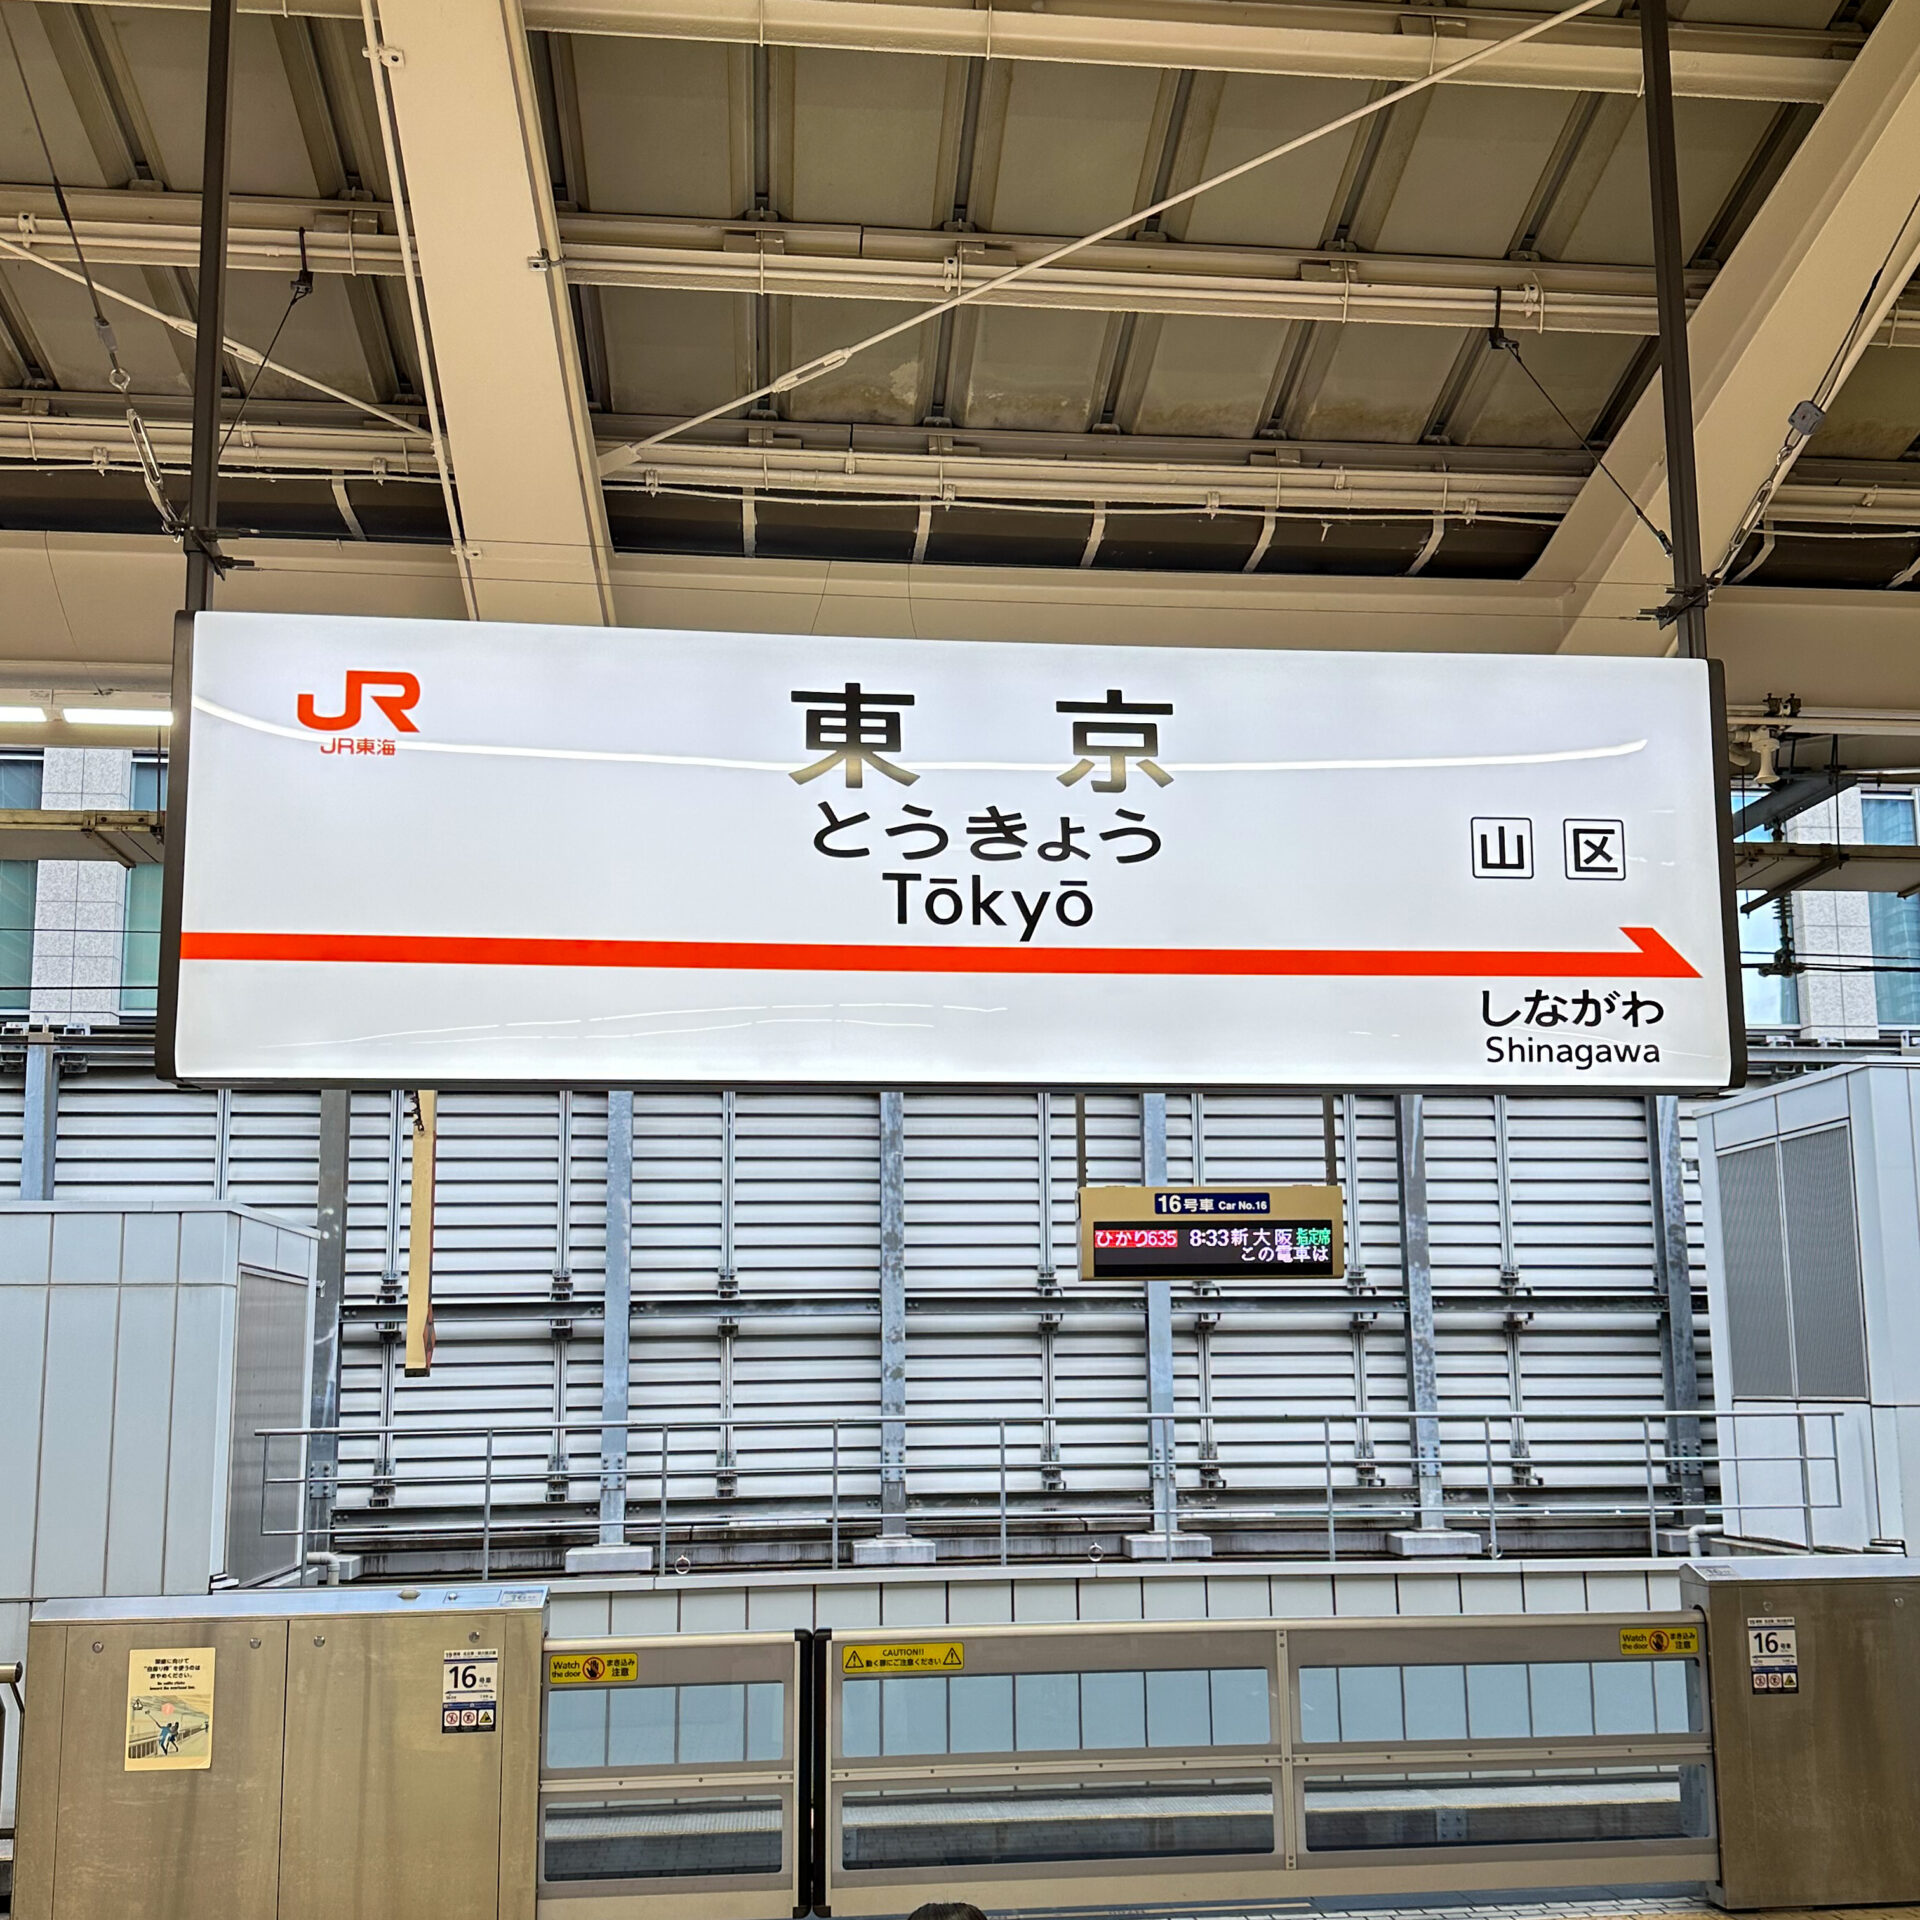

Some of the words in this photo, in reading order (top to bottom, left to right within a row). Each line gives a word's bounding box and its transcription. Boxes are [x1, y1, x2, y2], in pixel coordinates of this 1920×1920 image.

[296, 670, 421, 733] JR
[320, 738, 396, 756] JR東海
[788, 682, 1175, 794] 東京
[813, 801, 1162, 865] とうきょう
[1479, 825, 1525, 870] 山
[1572, 828, 1619, 873] 区
[882, 872, 1094, 942] Tōkyō
[1481, 988, 1665, 1028] しながわ
[1485, 1036, 1661, 1070] Shinagawa
[1218, 1200, 1236, 1210] Car
[1238, 1200, 1267, 1210] No.16
[1189, 1228, 1230, 1247] 8:33
[1231, 1227, 1293, 1247] 新大阪
[1241, 1246, 1330, 1264] この電車は
[1622, 1633, 1647, 1642] Watch
[1753, 1632, 1779, 1653] 16
[553, 1660, 580, 1670] Watch
[564, 1670, 581, 1678] door
[448, 1665, 477, 1689] 16
